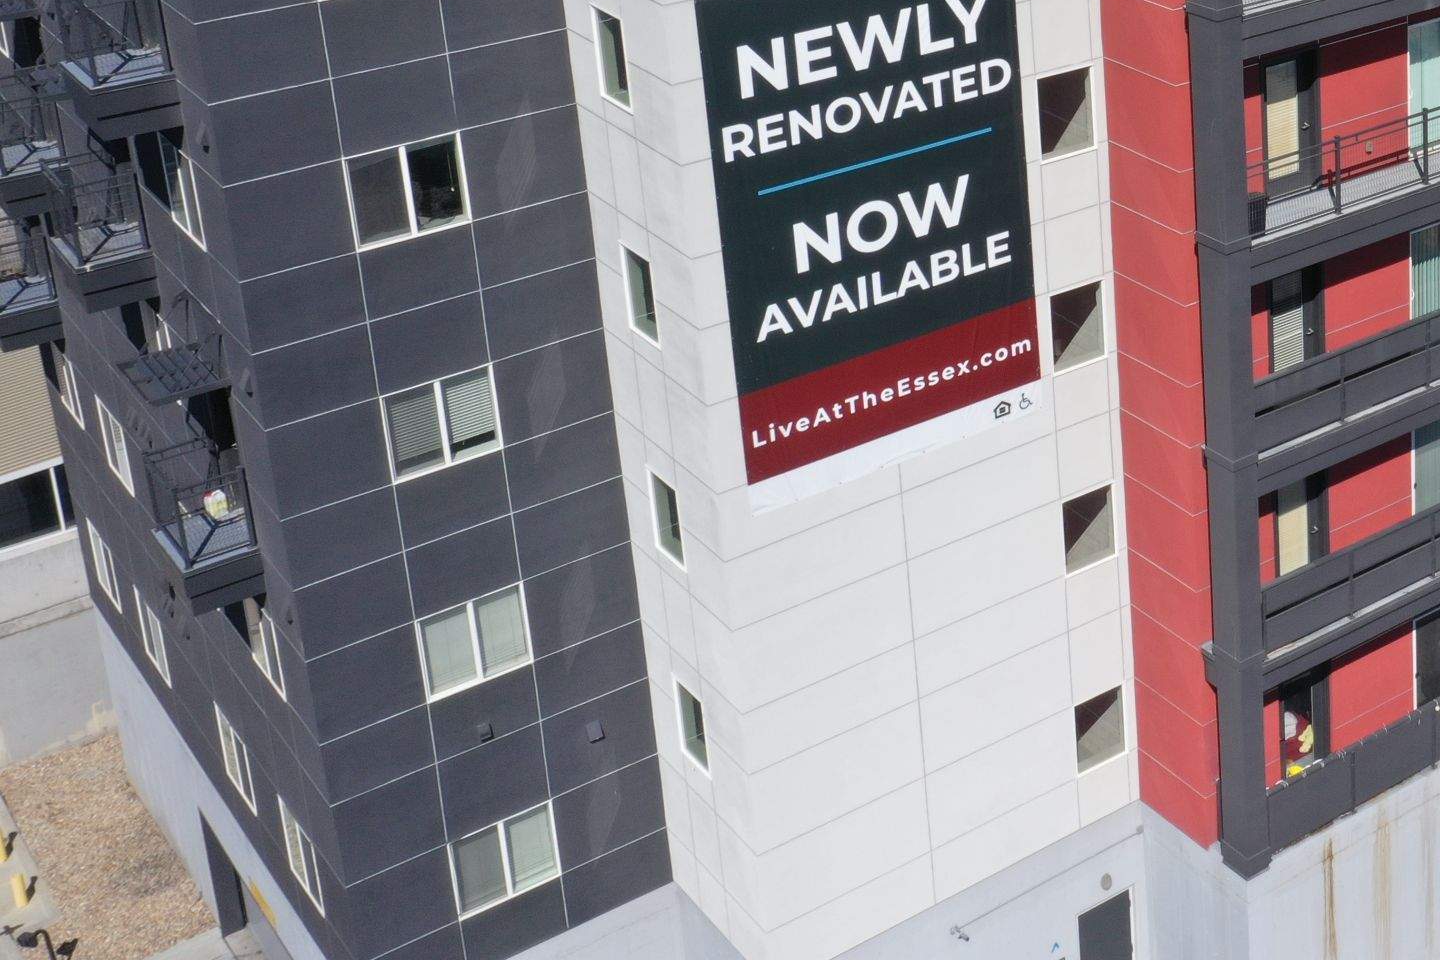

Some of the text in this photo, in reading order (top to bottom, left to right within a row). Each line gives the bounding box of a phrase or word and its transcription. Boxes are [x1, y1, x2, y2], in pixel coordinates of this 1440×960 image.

[721, 58, 1012, 164] RENOVATED
[792, 173, 970, 275] NOW
[756, 230, 1012, 344] AVAILABLE
[752, 338, 1032, 449] LiveAtTheEssex.com
